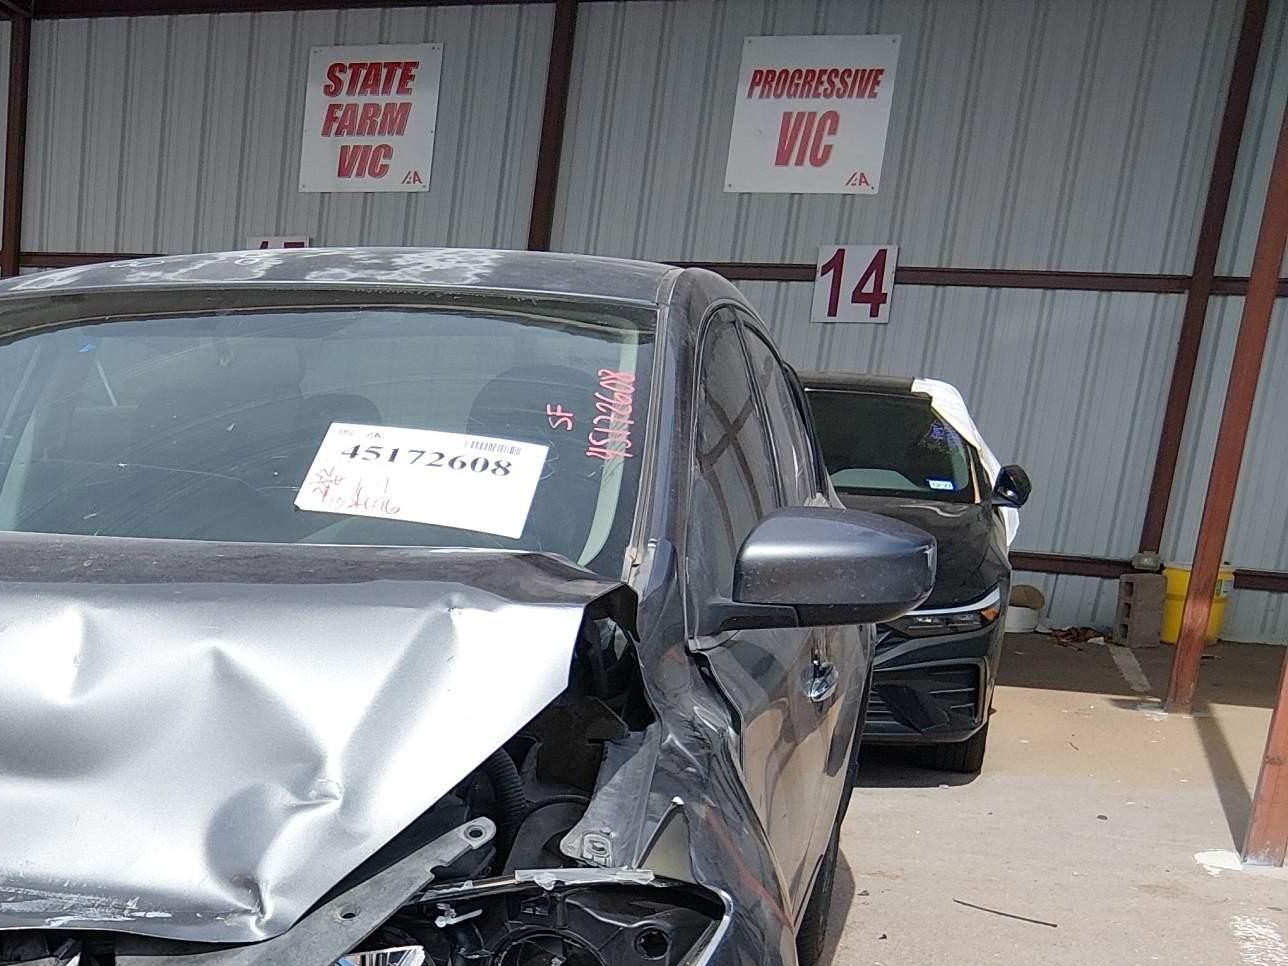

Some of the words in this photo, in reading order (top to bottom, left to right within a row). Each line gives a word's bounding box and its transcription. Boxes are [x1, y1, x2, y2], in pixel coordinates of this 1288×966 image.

[323, 61, 420, 97] STATE
[747, 68, 885, 99] PROGRESSIVE
[321, 102, 412, 137] FARM
[775, 110, 840, 168] VIC
[337, 143, 394, 179] VIC
[820, 248, 888, 318] 14
[546, 403, 574, 431] SF
[340, 443, 512, 478] 45172608
